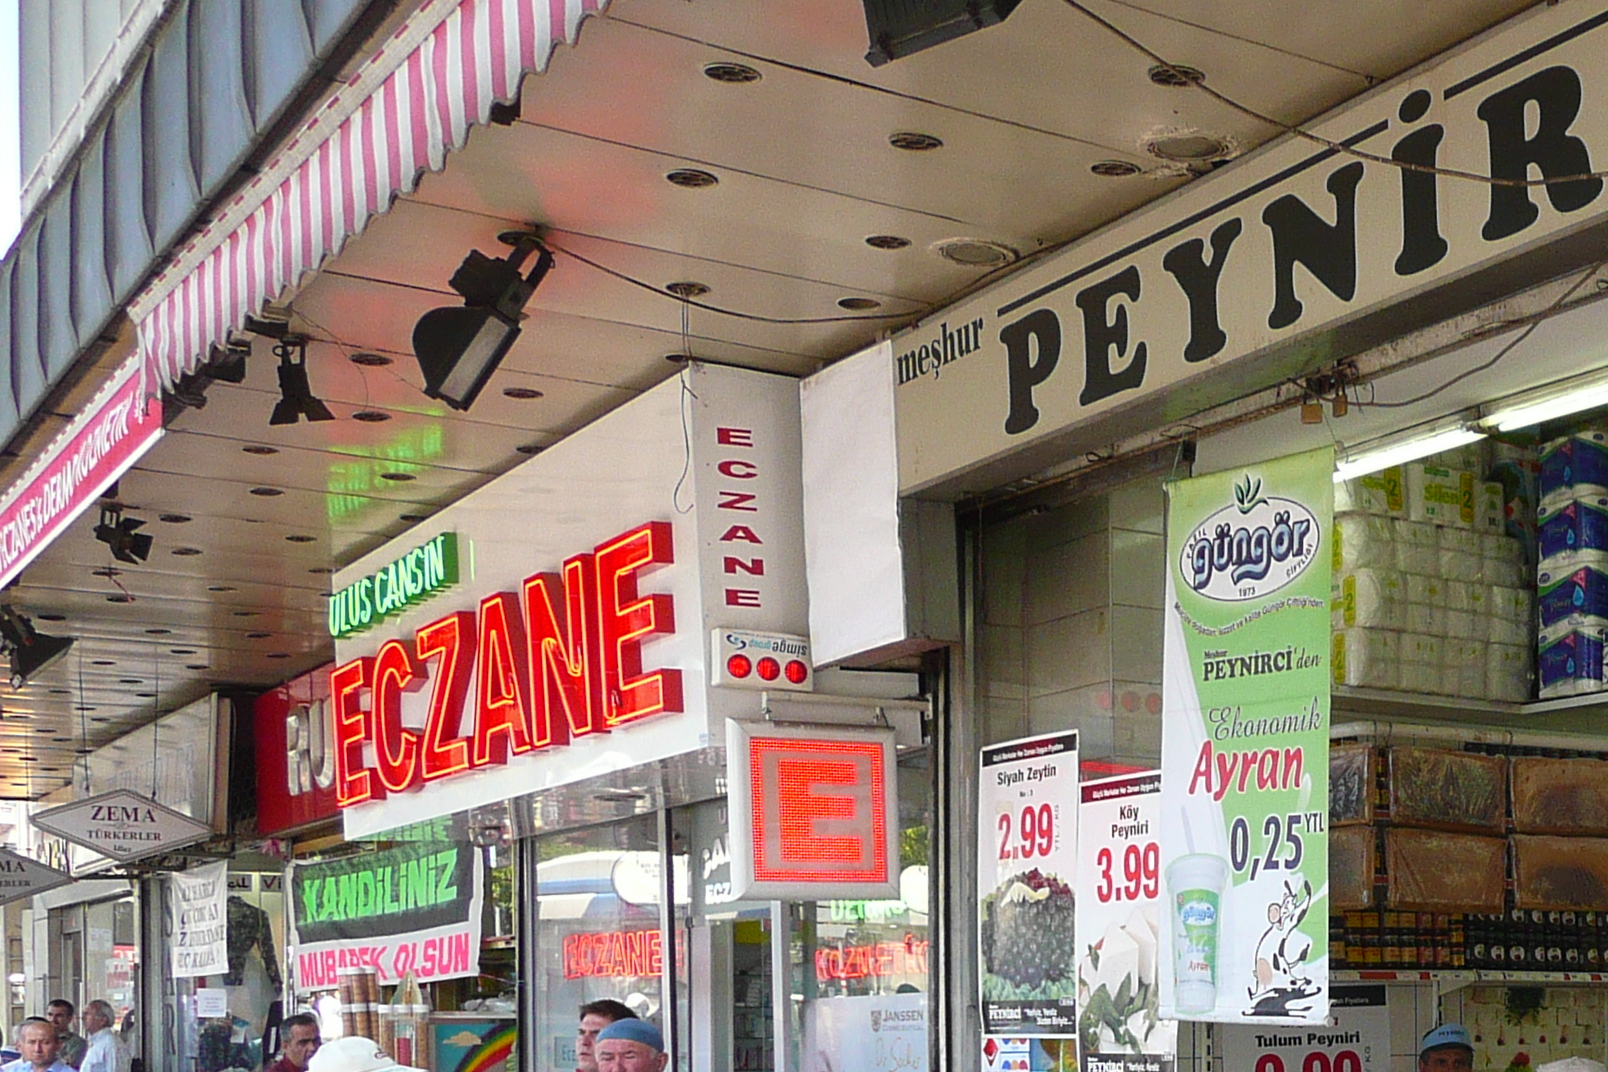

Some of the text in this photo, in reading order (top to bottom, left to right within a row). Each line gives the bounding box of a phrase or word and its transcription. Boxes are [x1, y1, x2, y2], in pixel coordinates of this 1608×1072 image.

[896, 319, 984, 389] meşhur
[715, 426, 765, 608] ECZANE
[1191, 509, 1311, 591] güngör
[329, 577, 373, 637] ULUS
[1238, 586, 1256, 598] 1973
[329, 521, 682, 808] ECZANE
[1208, 695, 1322, 742] Ekonomik
[996, 764, 1057, 787] Siyah Zeytin
[1187, 739, 1304, 802] Ayran
[86, 829, 163, 842] TÜRKERLER
[91, 805, 157, 823] ZEMA
[997, 802, 1054, 861] 2.99
[1111, 819, 1149, 840] Peyniri
[1119, 804, 1140, 822] Köy
[1096, 841, 1159, 903] 3.99
[1230, 811, 1325, 881] 0,25 YTL
[303, 846, 459, 924] KANDİLİNİZ
[392, 932, 470, 980] OLSUN
[883, 1010, 924, 1023] JANSSEN
[1255, 1030, 1361, 1048] Tulum Peyniri
